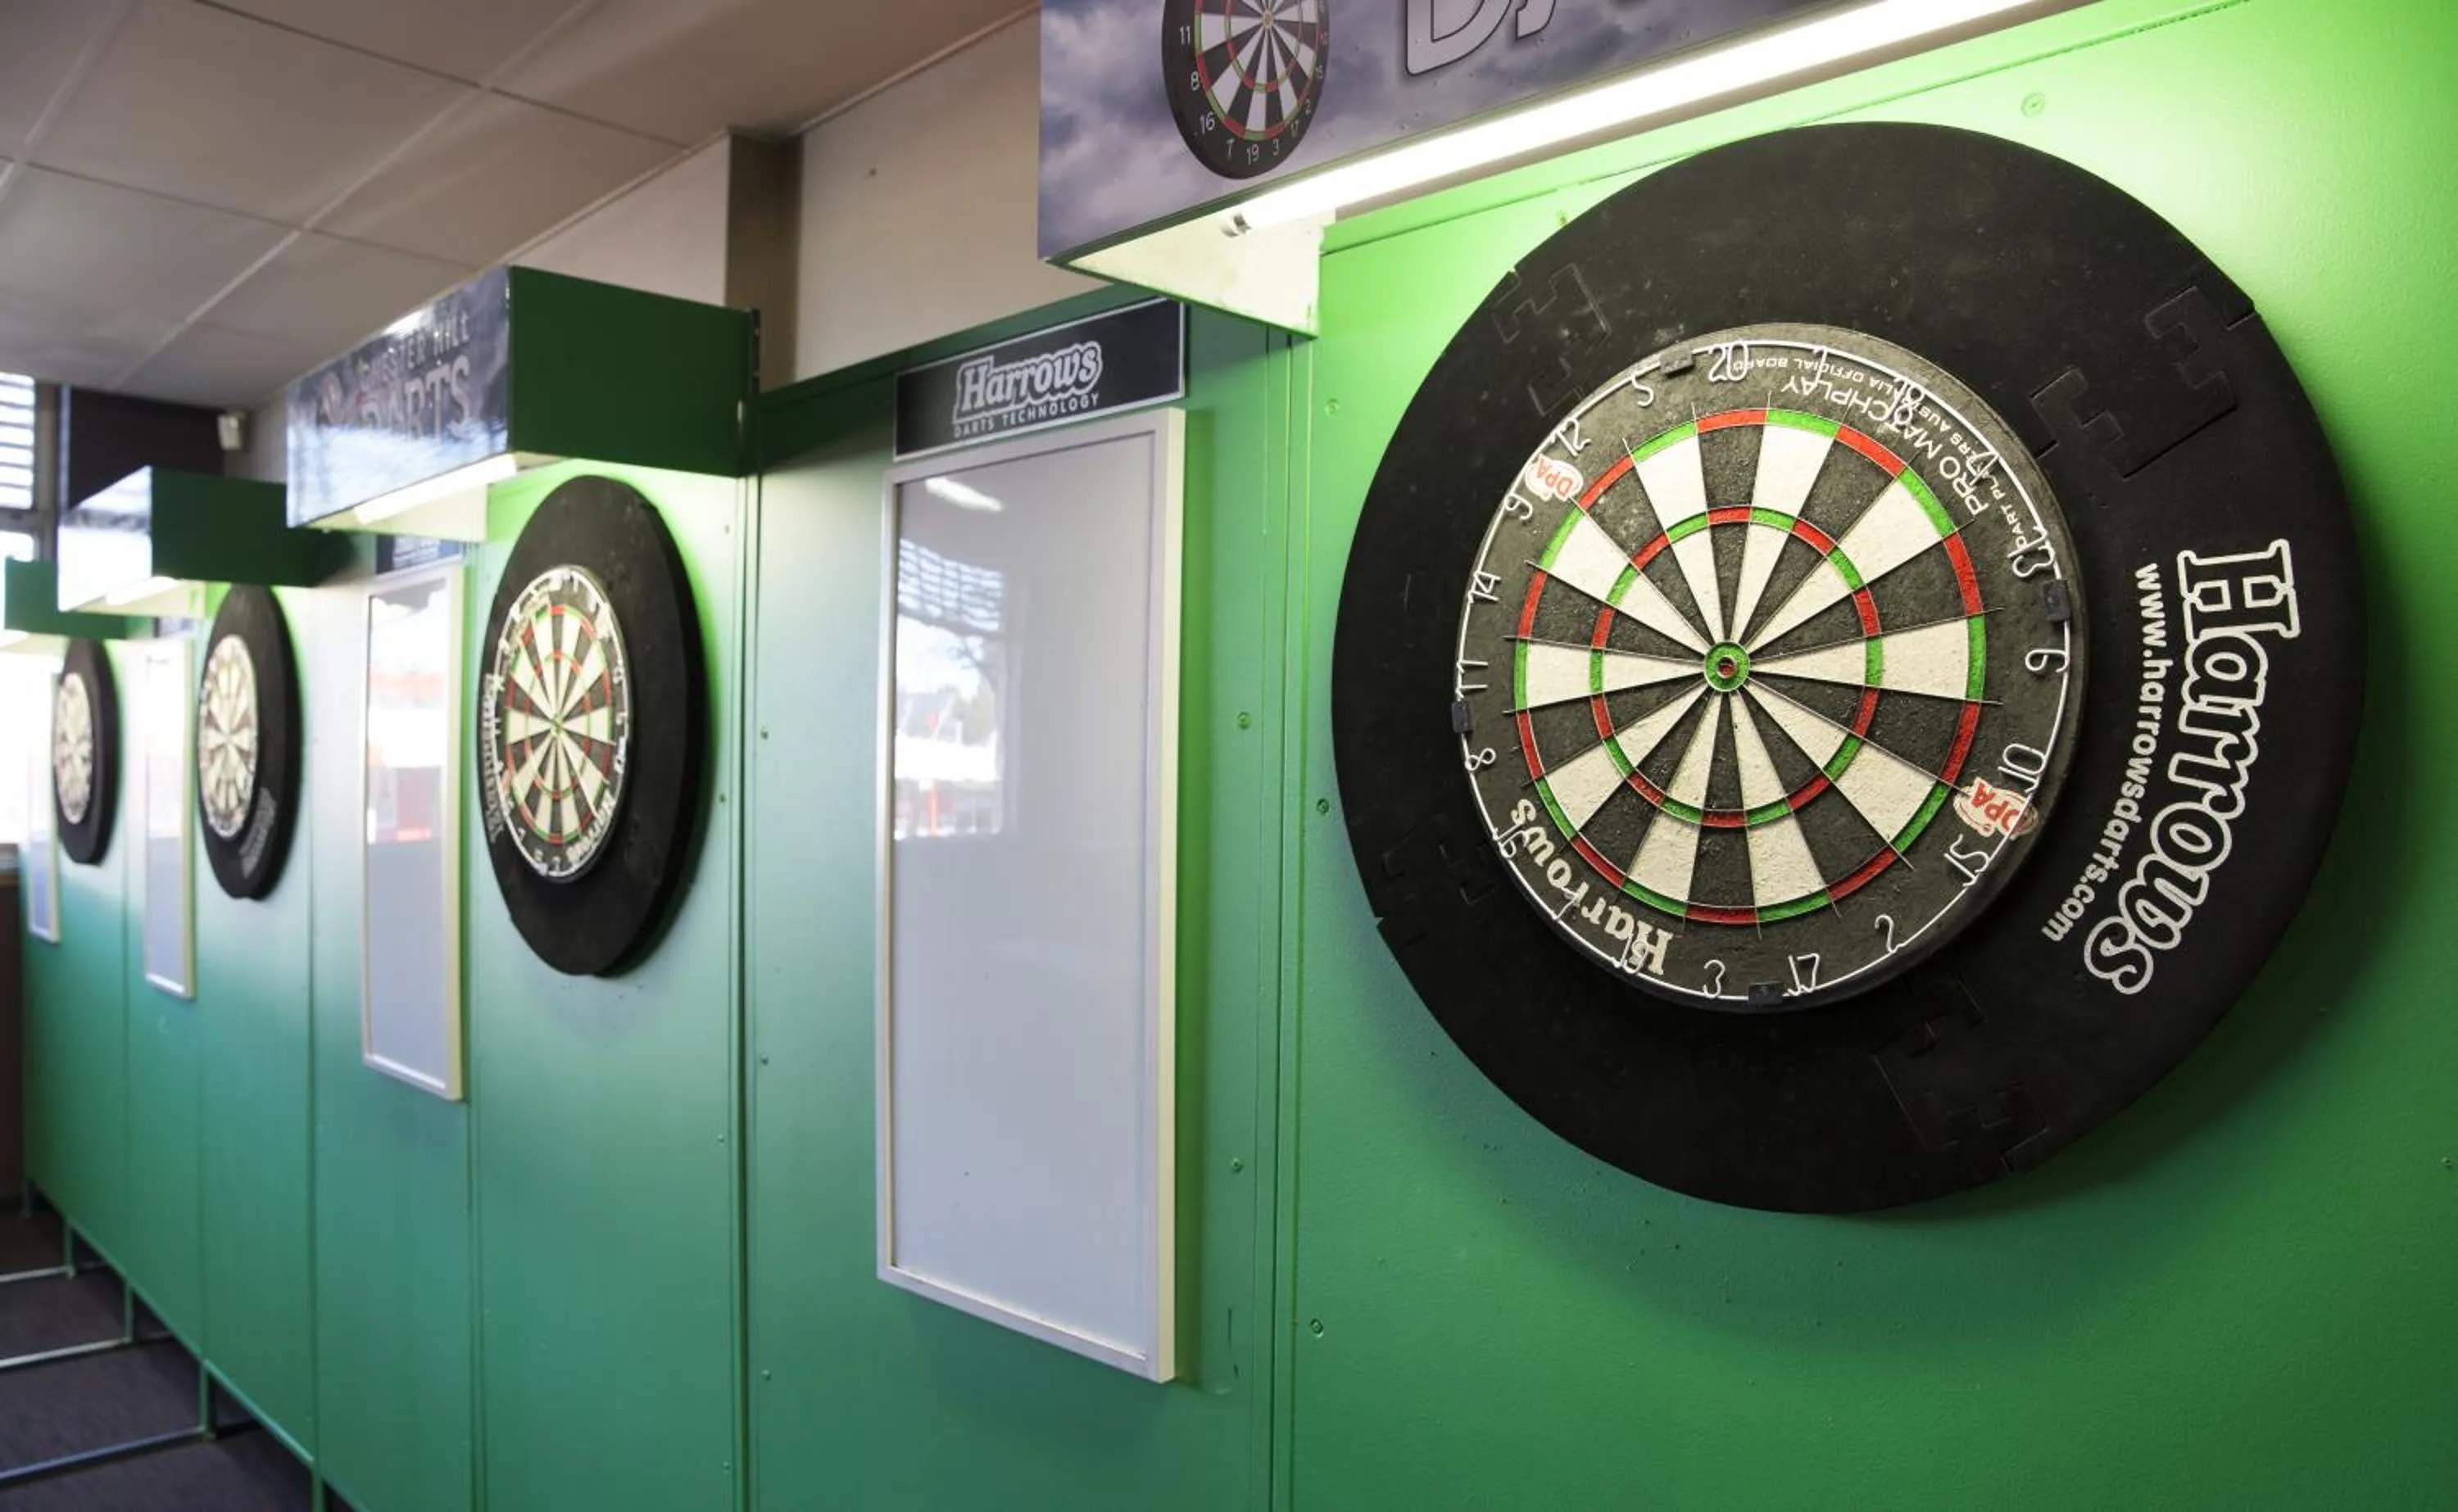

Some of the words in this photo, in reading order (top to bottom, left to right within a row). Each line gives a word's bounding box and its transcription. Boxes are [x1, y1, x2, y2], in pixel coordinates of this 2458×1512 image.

[1180, 25, 1190, 46] 11
[1190, 70, 1200, 91] 8
[1200, 112, 1215, 135] 16
[1226, 138, 1236, 159] 7
[1246, 143, 1259, 165] 19
[1272, 138, 1281, 156] 3
[959, 346, 1100, 413] Harrows
[1708, 340, 1749, 383] 20
[1794, 358, 1864, 383] OFFICIAL
[359, 354, 471, 442] DARTS
[1630, 375, 1654, 407] 5
[953, 417, 995, 439] DARTS
[1002, 392, 1100, 426] TECHNOLOGY
[1780, 374, 1943, 459] MATCHPLAY
[1550, 417, 1592, 457] 12
[1537, 456, 1575, 498] DPA
[1939, 456, 1989, 515] PRO
[1503, 491, 1534, 522] 9
[2007, 526, 2057, 578] 13
[1468, 571, 1501, 604] 14
[1456, 660, 1489, 699] 11
[1465, 747, 1498, 771] 8
[1997, 743, 2049, 794] 10
[2041, 562, 2175, 942] www.harrowsdarts.com
[2084, 539, 2301, 995] Harrows
[1970, 781, 2027, 834] DPA
[1943, 834, 1990, 887] 15
[1510, 799, 1675, 976] Harrows
[1874, 914, 1898, 954] 2
[1703, 959, 1726, 998] 3
[1785, 953, 1820, 996] 17
